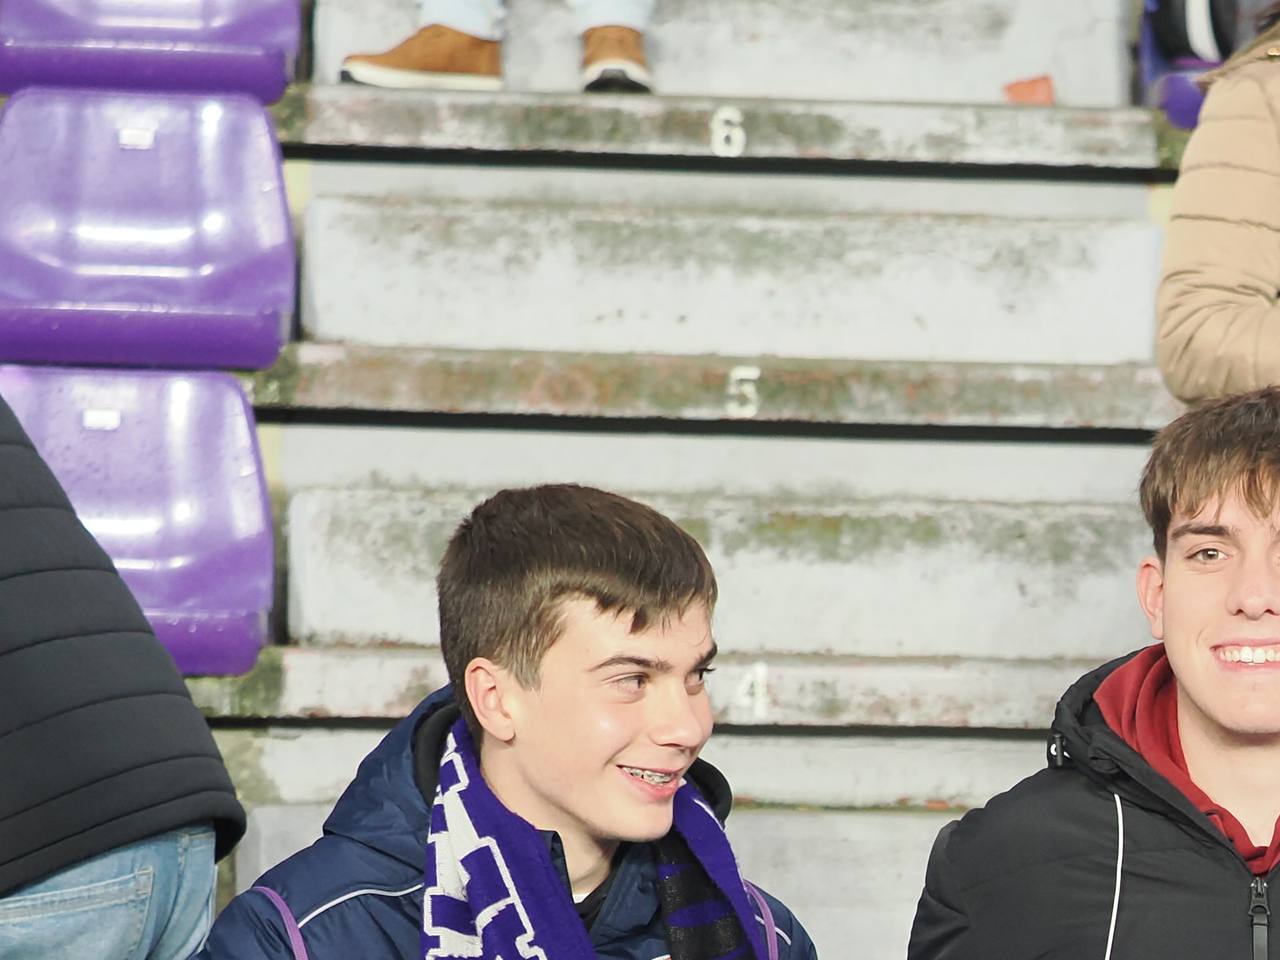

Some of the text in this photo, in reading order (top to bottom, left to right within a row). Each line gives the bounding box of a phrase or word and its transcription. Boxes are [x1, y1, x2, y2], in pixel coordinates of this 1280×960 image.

[709, 106, 746, 157] 6
[726, 366, 760, 417] 5
[735, 661, 769, 718] 4
